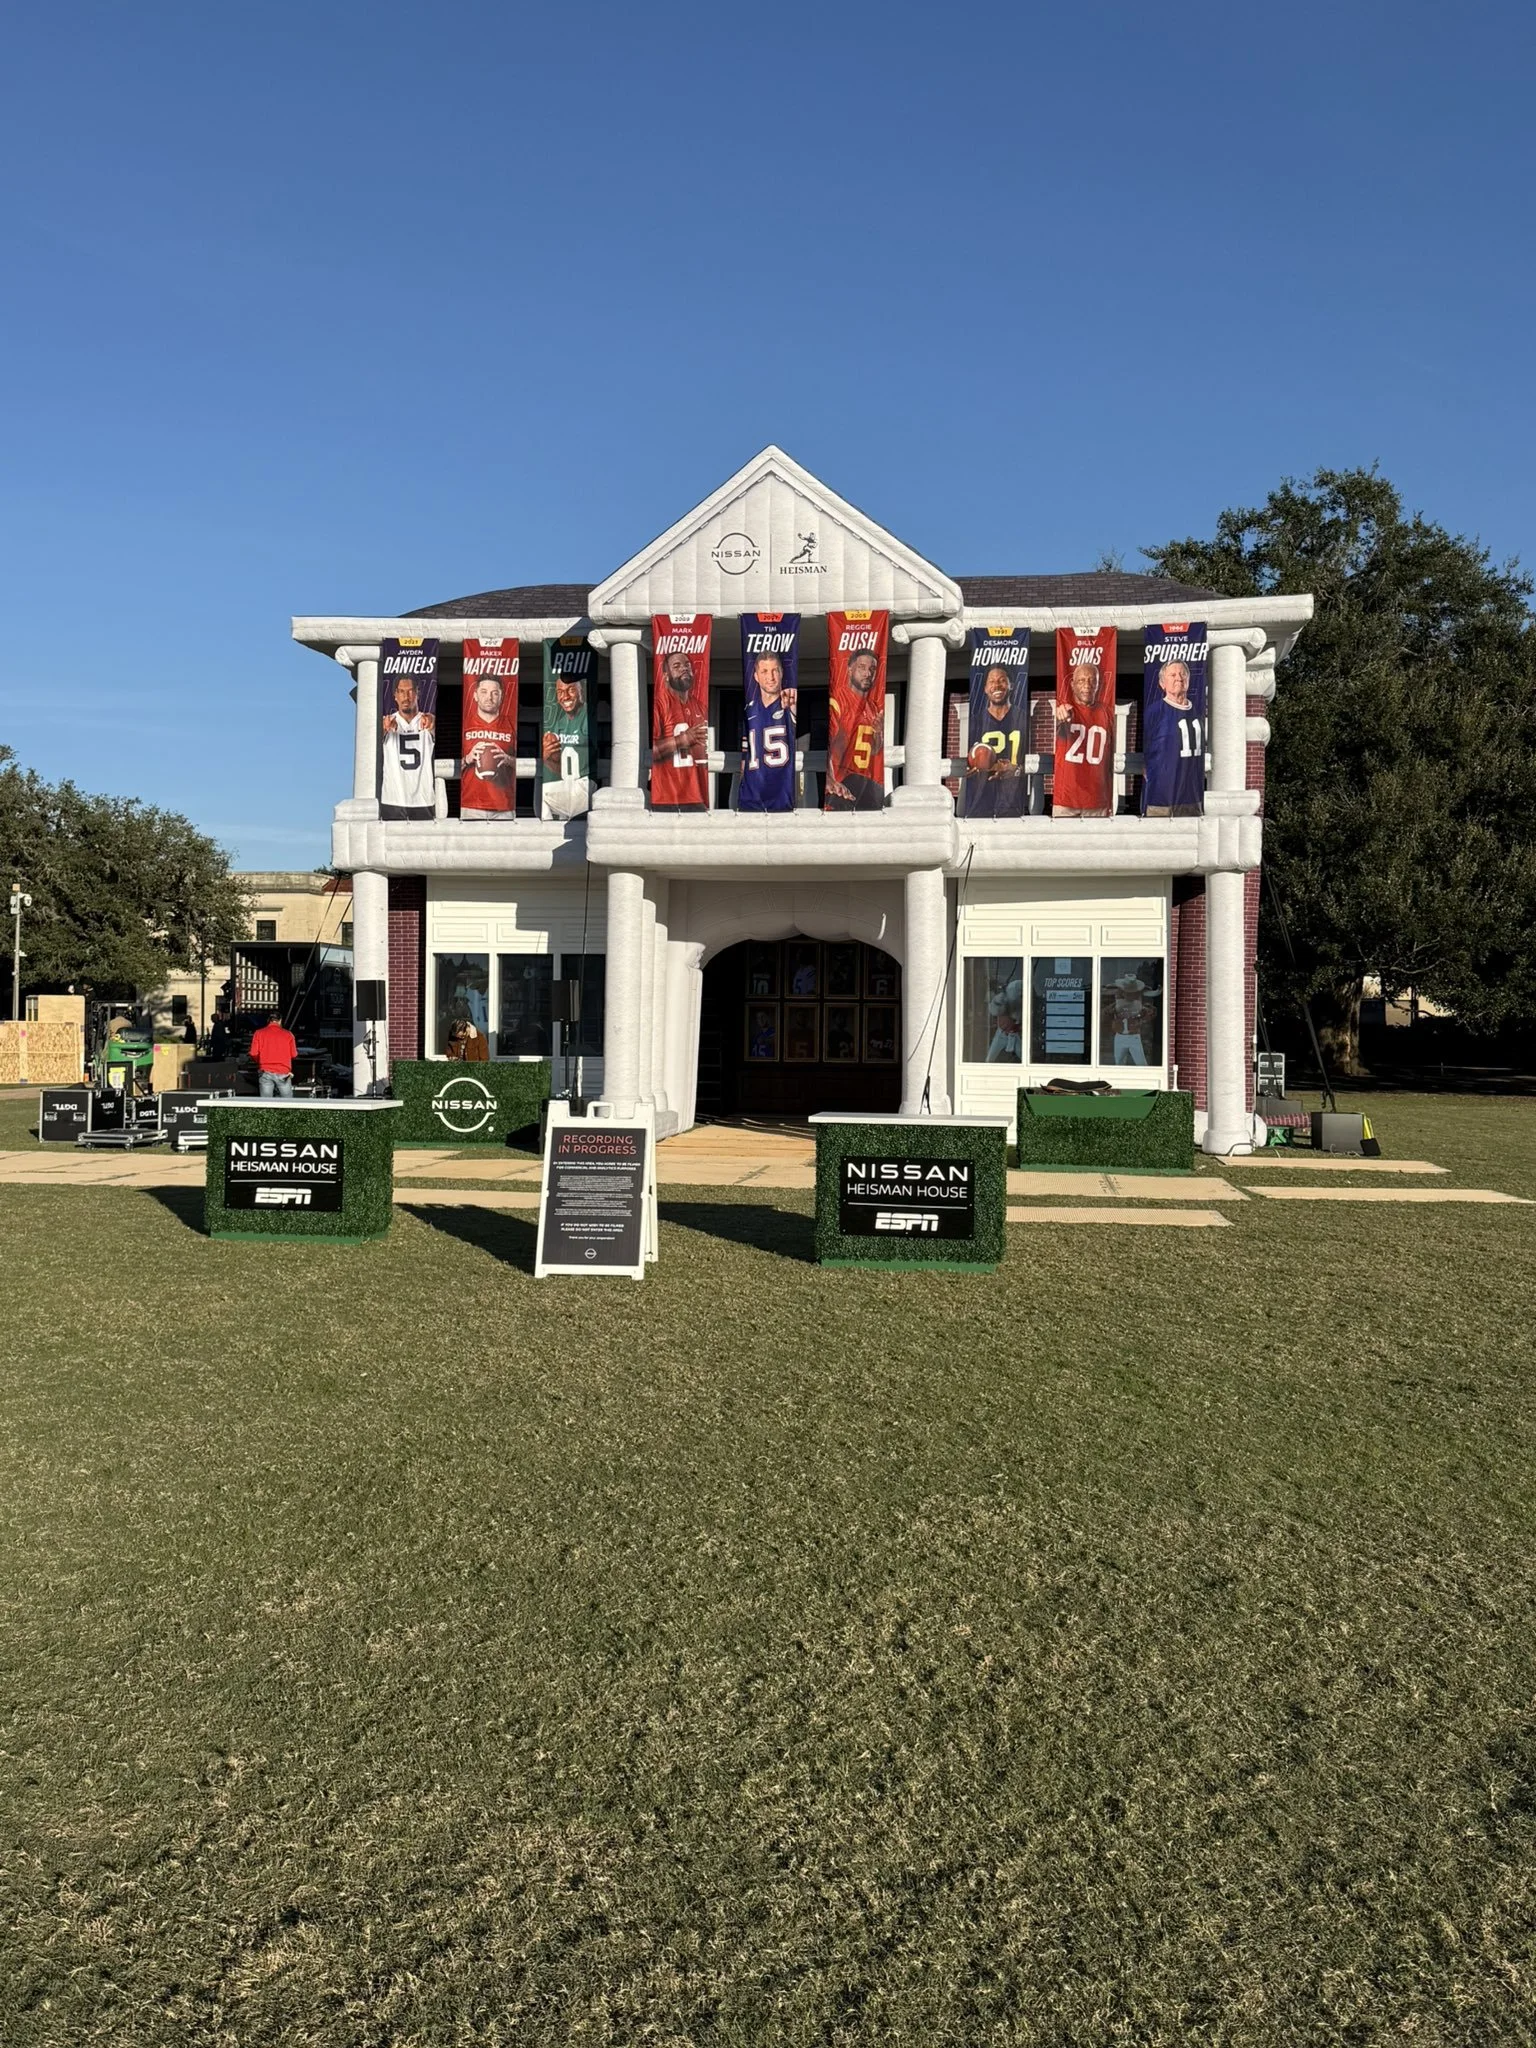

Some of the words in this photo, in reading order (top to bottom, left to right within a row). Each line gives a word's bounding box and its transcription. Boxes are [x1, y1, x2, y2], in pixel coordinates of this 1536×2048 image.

[711, 550, 761, 558] NISSAN
[780, 566, 828, 574] HEISMAN
[656, 635, 708, 655] INGRAM
[838, 631, 878, 651] BUSH
[971, 647, 1028, 666] HOWARD
[1069, 647, 1103, 666] SIMS
[1143, 642, 1210, 663] SPURRIER
[384, 656, 437, 674] DANIELS
[463, 657, 520, 675] MAYFIELD
[552, 651, 591, 674] RGIII
[465, 731, 512, 743] SOONERS
[1064, 723, 1107, 765] 20
[1178, 718, 1202, 758] 11
[400, 734, 420, 770] 5
[748, 725, 790, 770] 15
[854, 725, 876, 769] 5
[1044, 978, 1057, 988] TOP
[1057, 978, 1083, 988] SCORES
[431, 1100, 497, 1110] NISSAN
[563, 1135, 633, 1145] RECORDING
[231, 1141, 338, 1159] NISSAN
[558, 1145, 571, 1153] IN
[573, 1145, 637, 1155] PROGRESS
[231, 1160, 289, 1173] HEISMAN
[292, 1162, 337, 1175] HOUSE
[847, 1163, 969, 1181] NISSAN
[255, 1187, 312, 1205] ESPN
[847, 1183, 913, 1196] HEISMAN
[917, 1185, 968, 1199] HOUSE
[875, 1212, 939, 1232] ESPN
